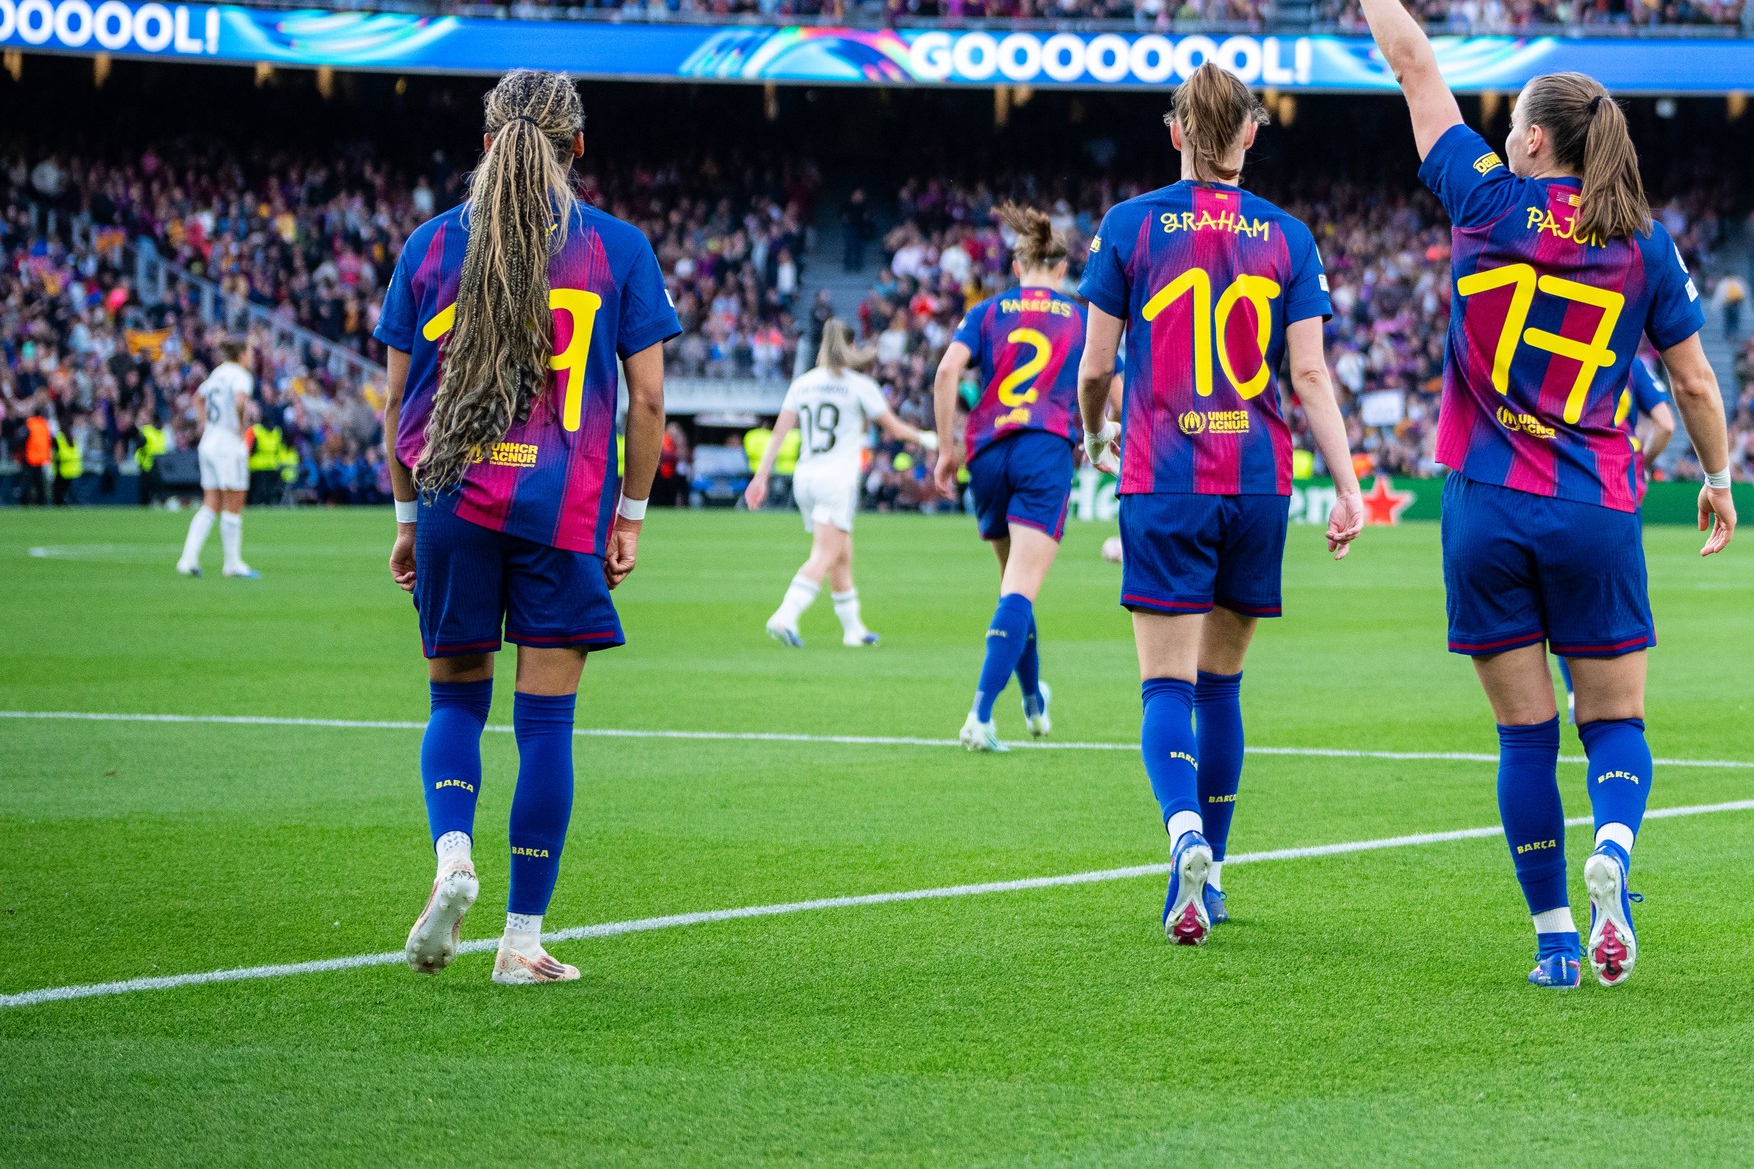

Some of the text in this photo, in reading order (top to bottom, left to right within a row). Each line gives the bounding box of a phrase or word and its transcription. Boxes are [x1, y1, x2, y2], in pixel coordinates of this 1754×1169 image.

[909, 31, 1312, 85] GOOOOOOOL!
[1001, 299, 1073, 318] PAREDES
[1142, 267, 1281, 401] 10
[1457, 263, 1625, 424] 17
[998, 327, 1053, 408] 2
[1208, 411, 1248, 421] UNHCR
[800, 402, 840, 454] 19
[1208, 420, 1249, 430] ACNUR
[491, 442, 539, 454] UNHCR
[491, 451, 537, 464] ACNUR
[511, 845, 549, 859] BARÇA
[1517, 839, 1557, 855] BARÇA
